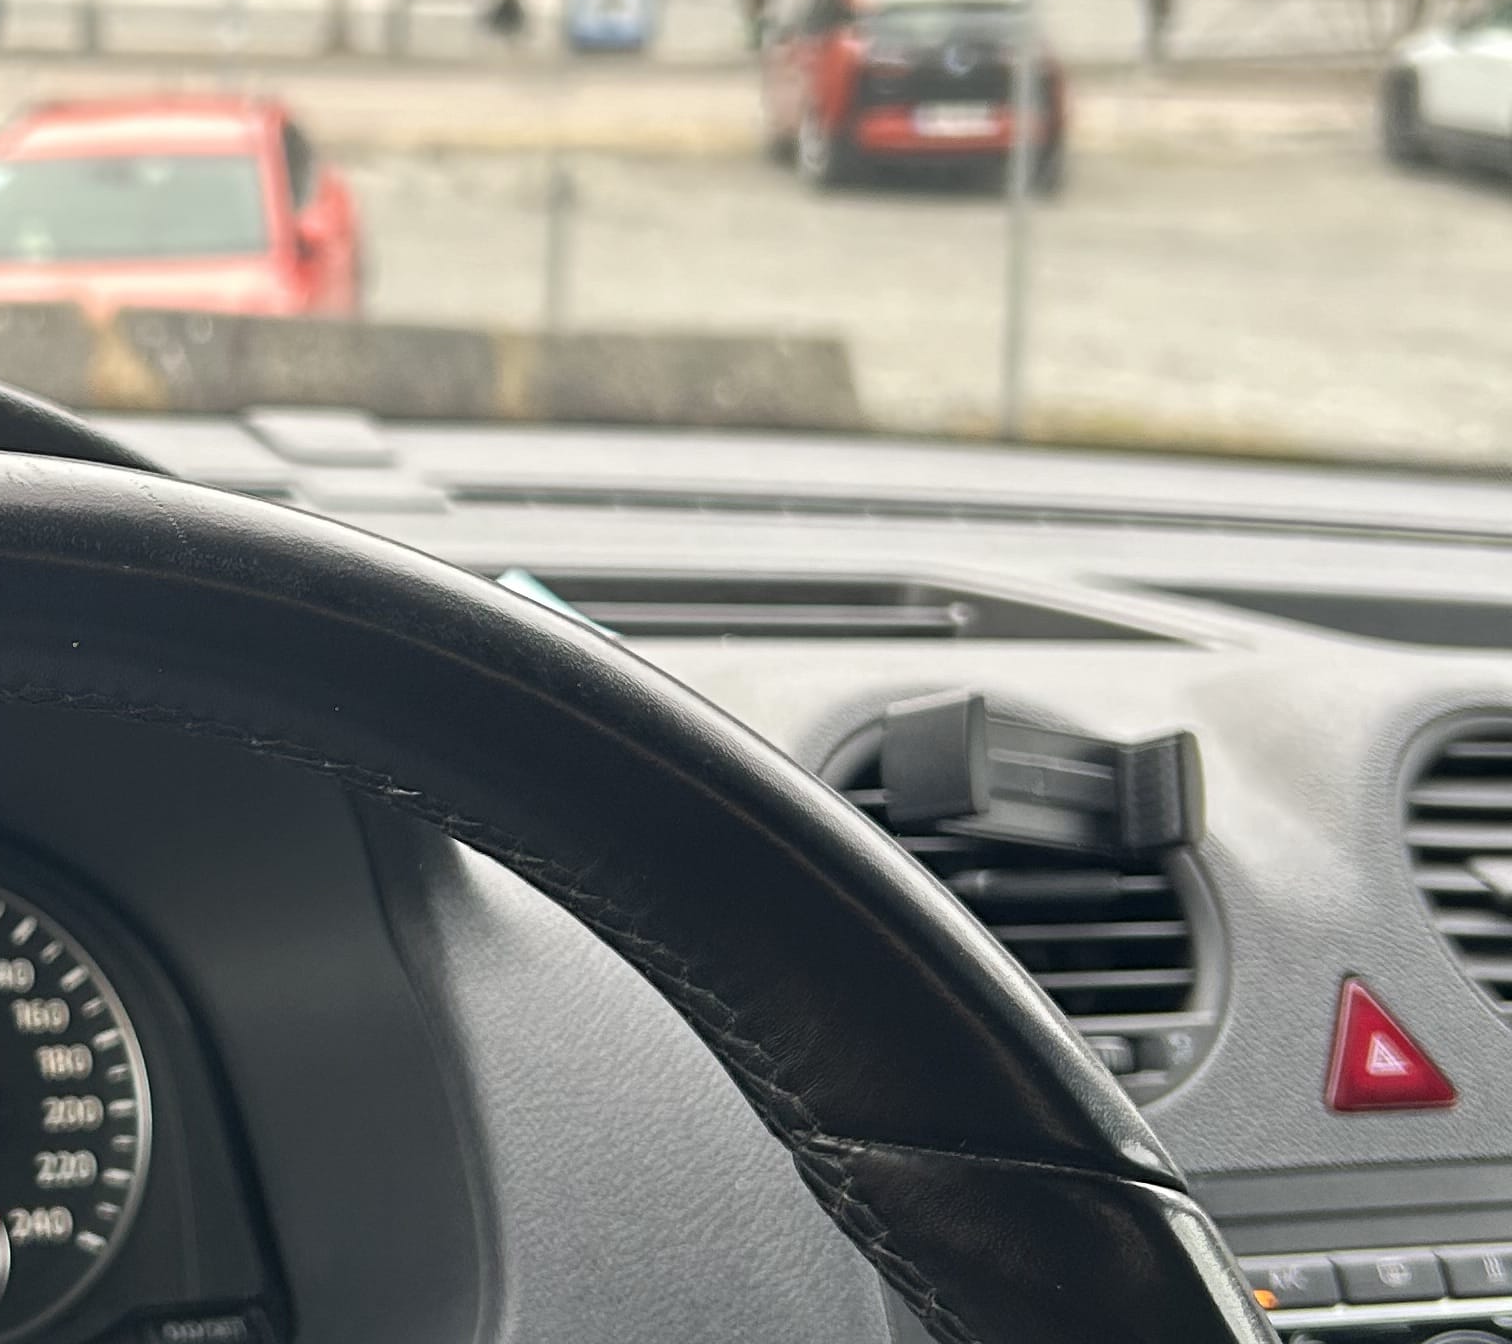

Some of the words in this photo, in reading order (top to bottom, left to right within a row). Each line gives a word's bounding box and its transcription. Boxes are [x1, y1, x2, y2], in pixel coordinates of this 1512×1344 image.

[11, 997, 70, 1034] 160
[35, 1044, 93, 1080] 180
[43, 1095, 104, 1133] 200
[35, 1150, 97, 1188] 220
[8, 1206, 73, 1243] 240
